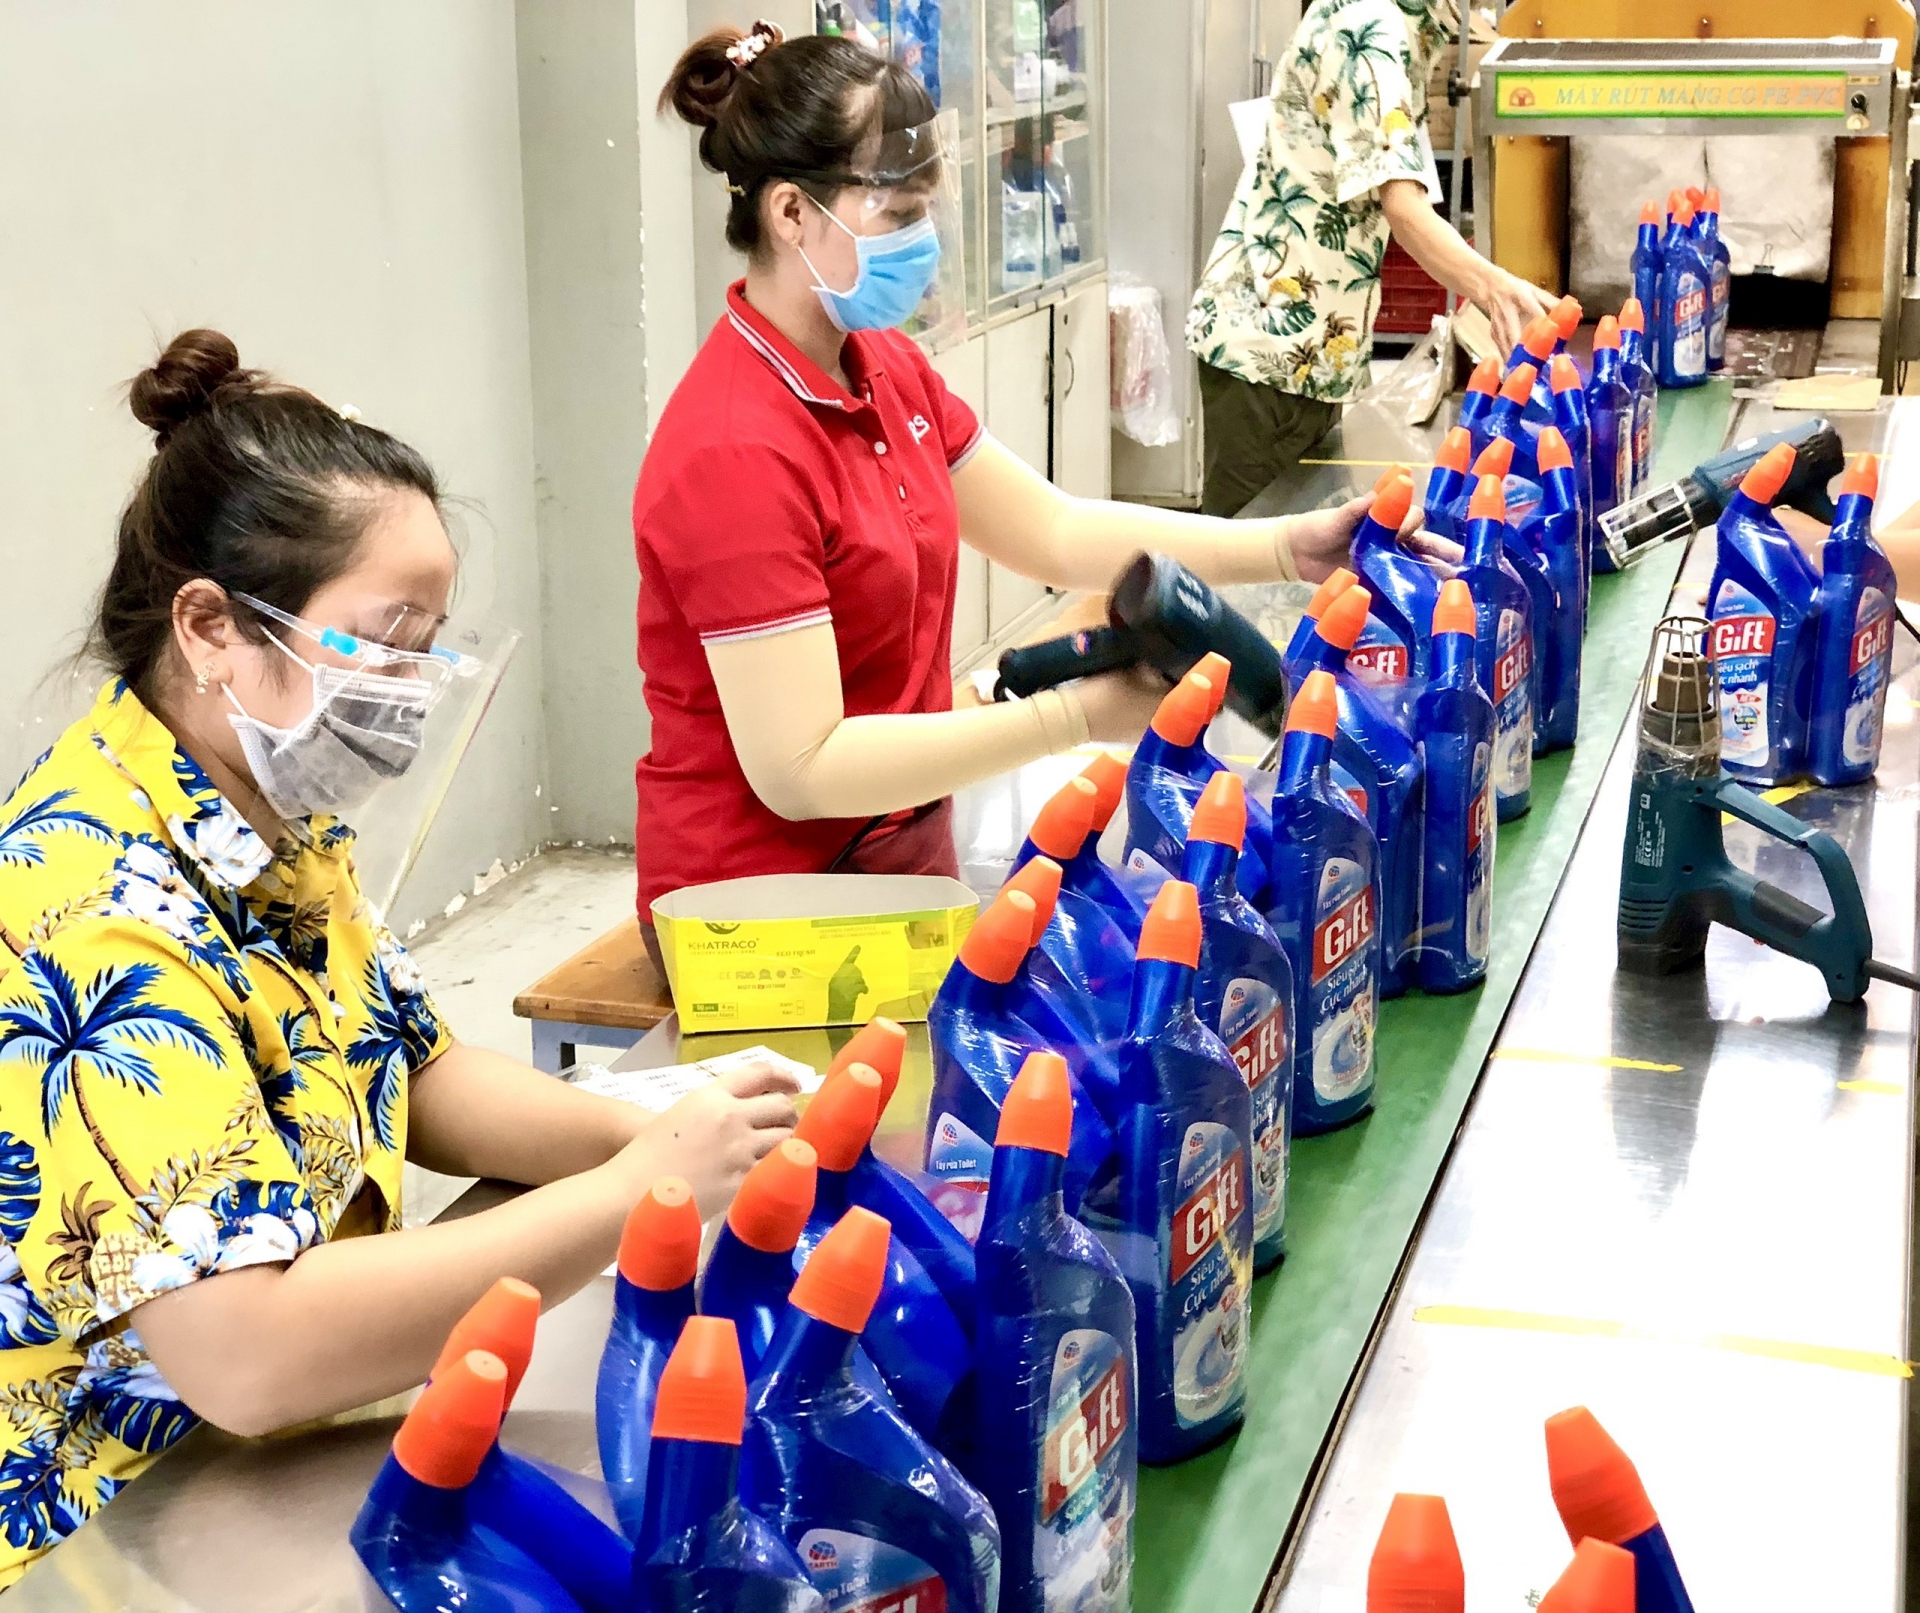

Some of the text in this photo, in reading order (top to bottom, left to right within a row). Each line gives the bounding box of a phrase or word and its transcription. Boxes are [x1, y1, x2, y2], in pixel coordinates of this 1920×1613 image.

[1727, 86, 1758, 104] CO
[1716, 621, 1766, 653] Gift
[1857, 618, 1886, 663] Gift
[1353, 651, 1398, 680] ft
[1501, 640, 1527, 690] Gift
[1717, 661, 1733, 673] iêu
[1728, 671, 1757, 684] nhanh
[1324, 895, 1369, 964] Gift
[689, 940, 757, 950] KHATRACO
[1322, 995, 1341, 1011] Cực
[1187, 1162, 1239, 1255] Gift
[1191, 1260, 1215, 1290] Siêu
[1183, 1288, 1208, 1315] Cực
[1060, 1372, 1121, 1487] Gift
[809, 1561, 837, 1571] EARTH
